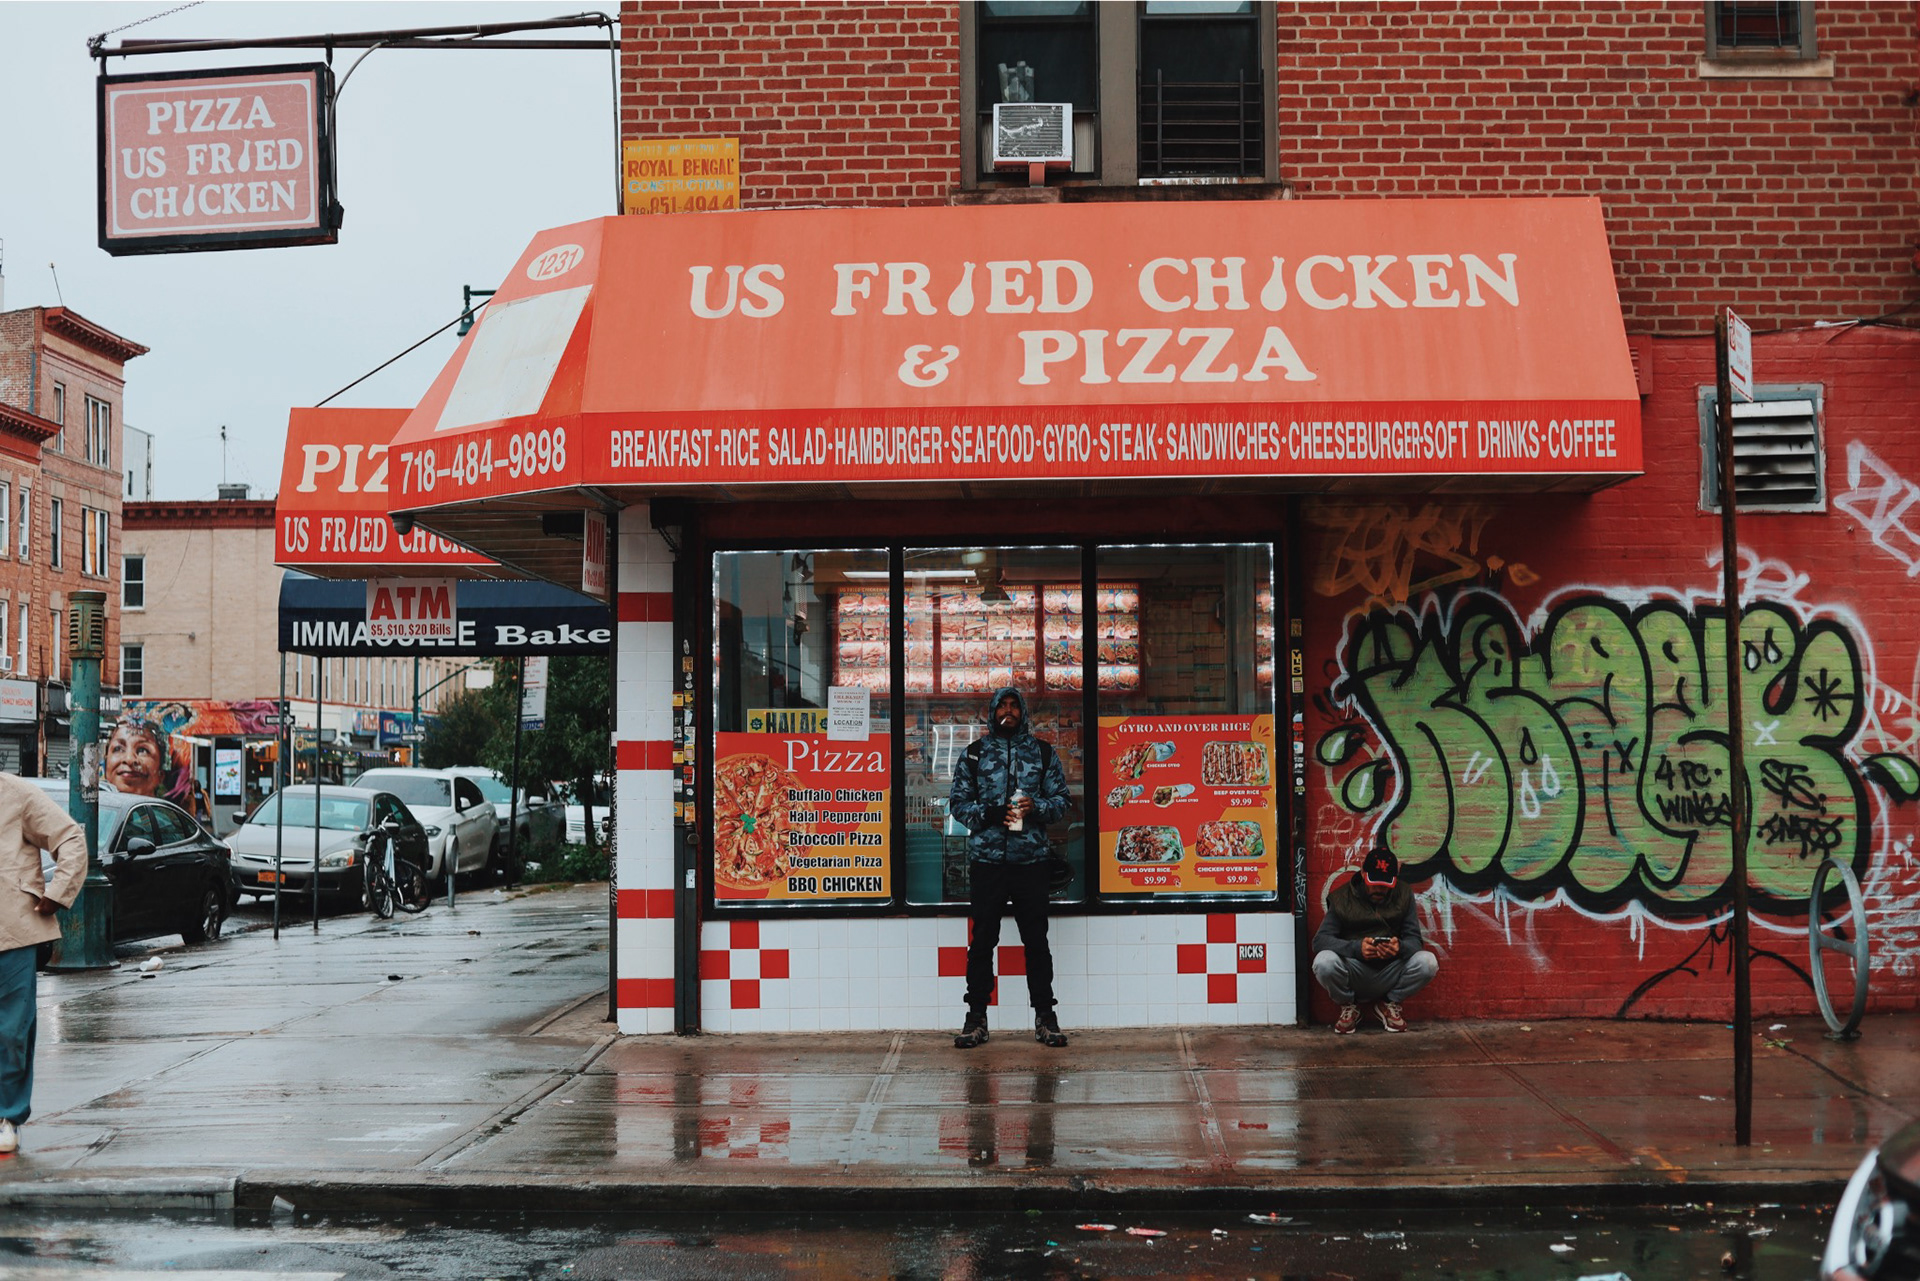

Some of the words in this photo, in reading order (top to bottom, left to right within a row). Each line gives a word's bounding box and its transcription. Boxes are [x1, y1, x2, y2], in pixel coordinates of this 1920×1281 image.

[146, 95, 276, 135] PIZZA
[121, 146, 167, 179] US
[186, 138, 303, 175] FRIED
[628, 159, 678, 178] ROYAL
[683, 158, 734, 176] BENGAL
[130, 180, 297, 219] CHICKEN
[536, 248, 579, 277] 1231
[688, 264, 785, 319] US
[831, 259, 1093, 316] FRIED
[1139, 253, 1520, 312] CHICKEN
[898, 344, 959, 387] &
[1018, 326, 1317, 385] PIZZA
[611, 428, 712, 467] BREAKFAST
[720, 428, 760, 466] RICE
[768, 427, 826, 465] SALAD
[835, 426, 942, 465] HAMBURGER
[951, 424, 1034, 463] SEAFOOD
[1043, 423, 1090, 462] GYRO
[1100, 423, 1157, 461] STEAK
[1166, 421, 1280, 461] SANDWICHES
[1288, 420, 1421, 460] CHEESEBURGER
[1423, 420, 1469, 459] SOFT
[1477, 419, 1540, 458] DRINKS
[1548, 419, 1617, 458] COFFEE
[400, 427, 566, 494] 718-484-9898
[284, 516, 310, 552] US
[320, 516, 388, 552] FRIED
[370, 586, 451, 621] ATM
[292, 621, 476, 647] IMMAE
[408, 623, 427, 636] $20
[429, 622, 451, 636] Bills
[1118, 723, 1153, 733] GYRO
[1155, 723, 1182, 732] AND
[1184, 723, 1218, 732] OVER
[1221, 722, 1250, 731] RICE
[783, 739, 886, 773] Pizza
[1655, 755, 1675, 790] 4
[788, 789, 831, 801] Buffalo
[835, 789, 883, 801] Chicken
[1230, 797, 1252, 806] $9.99
[789, 810, 818, 823] Halal
[822, 810, 882, 824] Pepperoni
[789, 832, 845, 846] Broccoli
[849, 832, 882, 846] Pizza
[789, 856, 850, 869] Vegetarian
[854, 856, 882, 868] Pizza
[788, 876, 817, 893] BBQ
[822, 876, 882, 892] CHICKEN
[1144, 876, 1167, 885] $9.99
[1226, 875, 1248, 884] $9.99
[1239, 945, 1264, 958] RICKS
